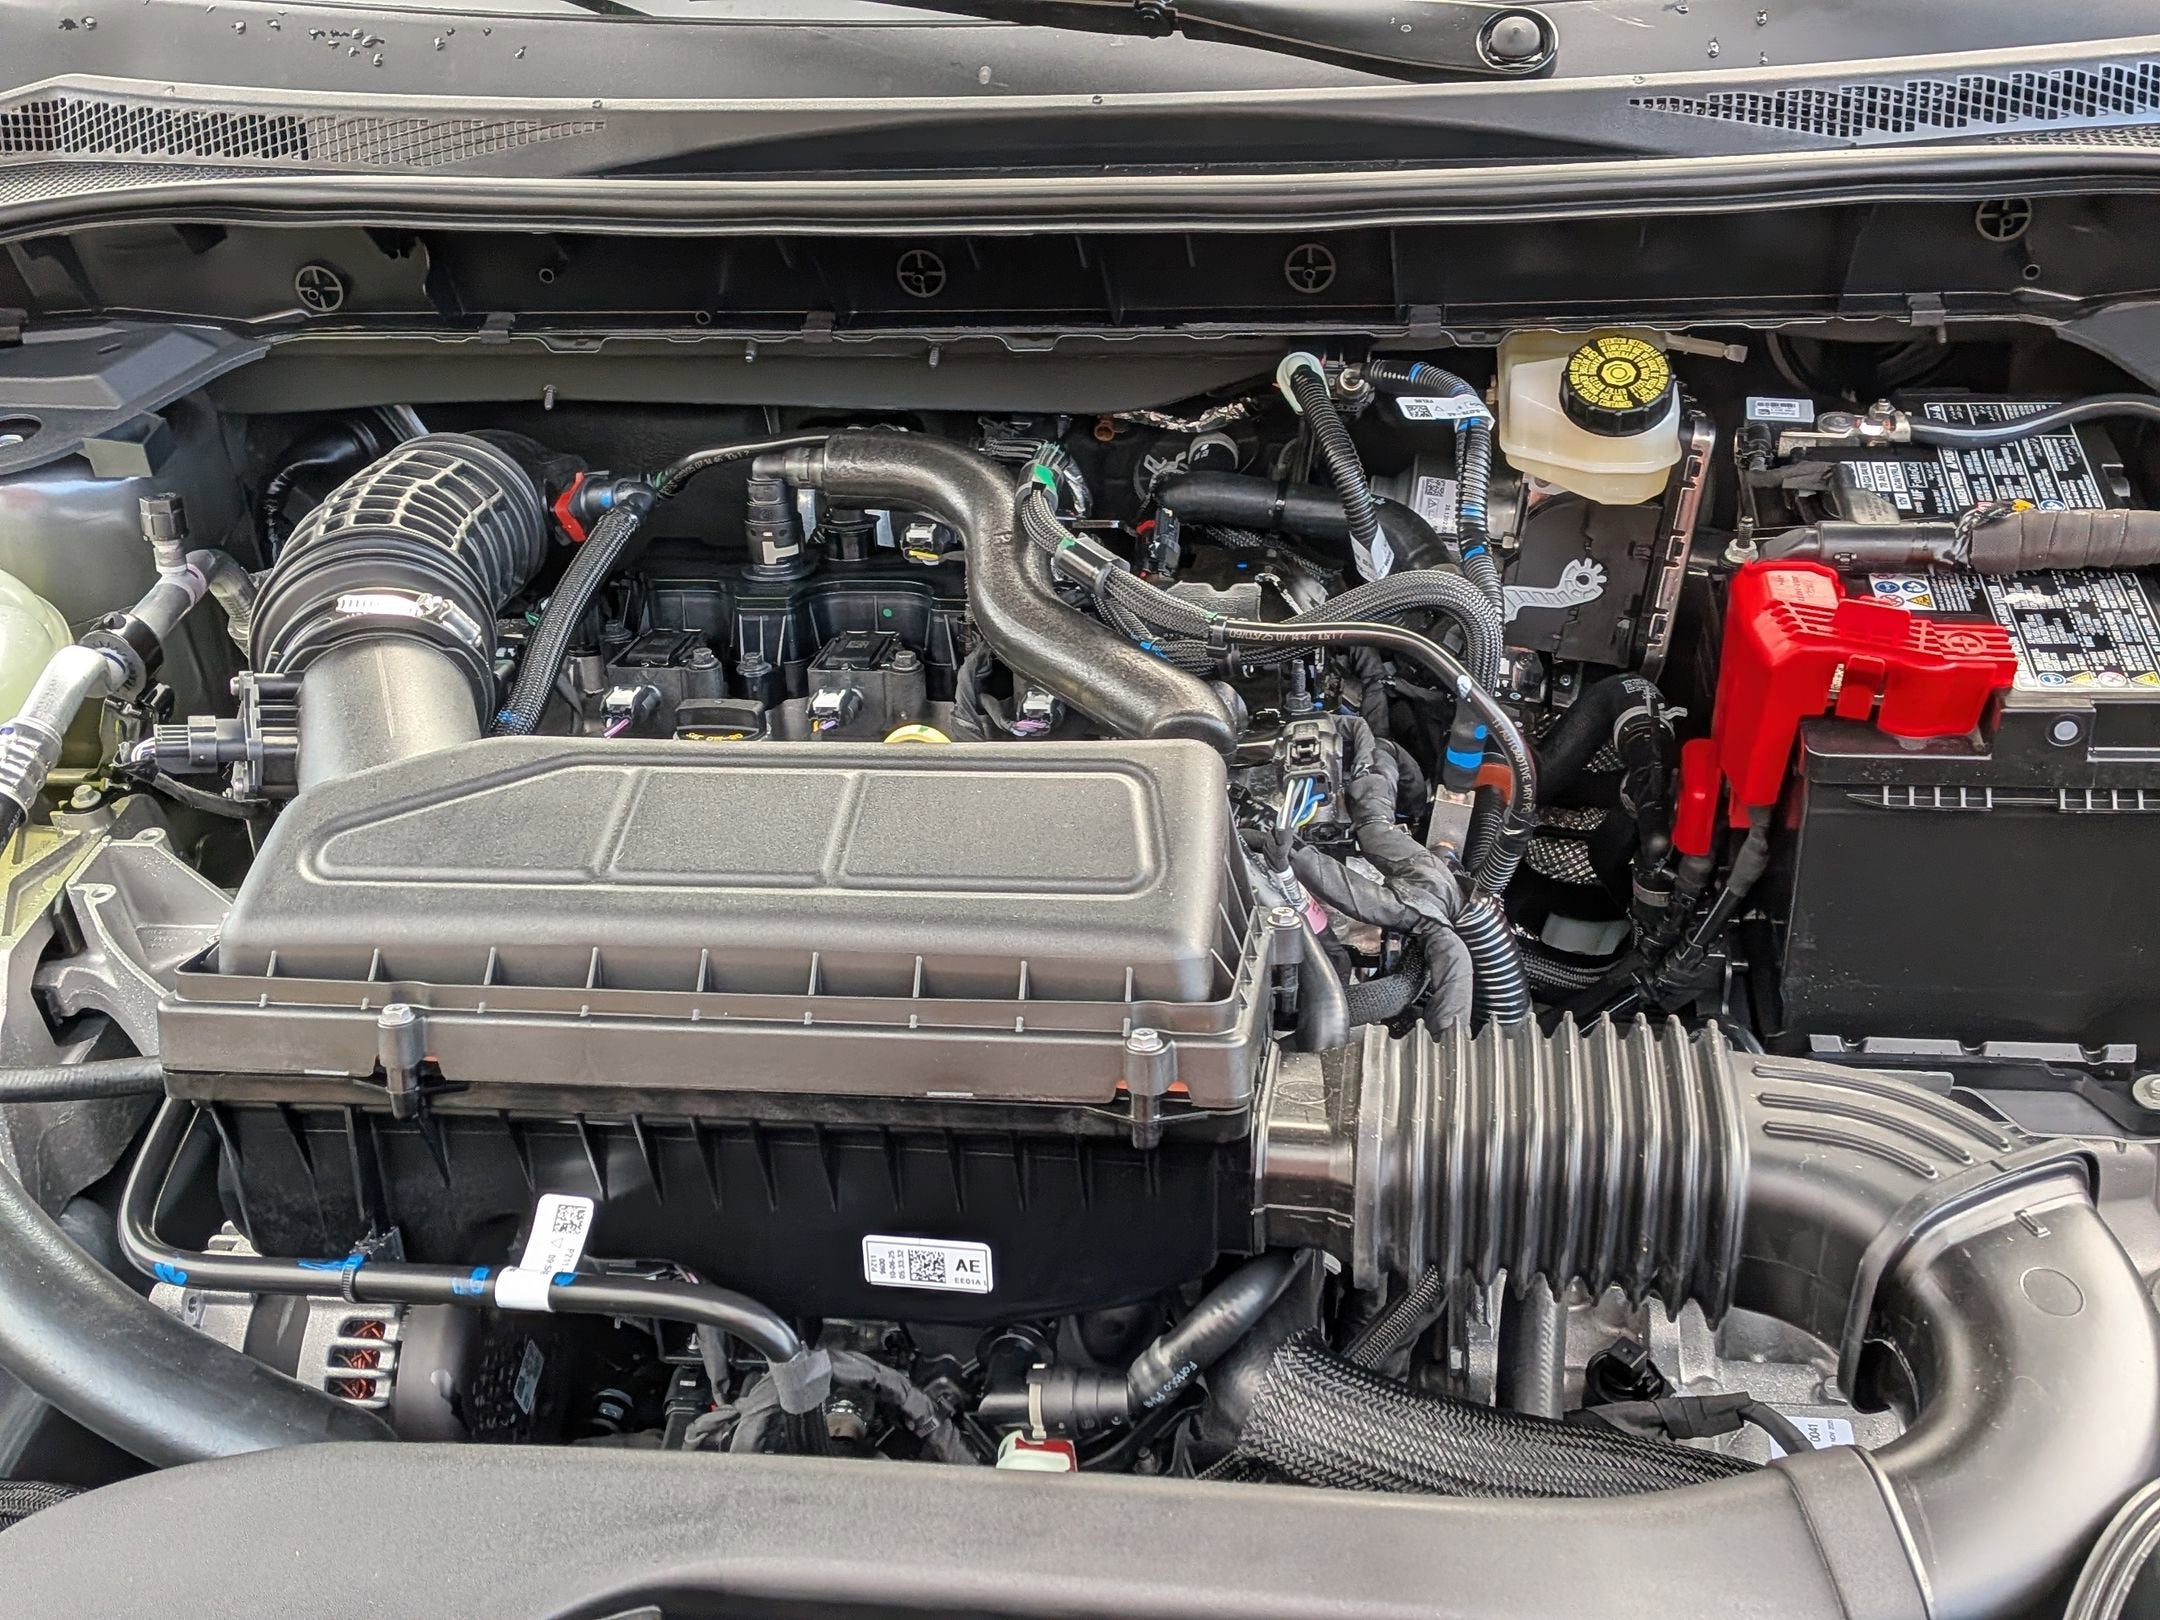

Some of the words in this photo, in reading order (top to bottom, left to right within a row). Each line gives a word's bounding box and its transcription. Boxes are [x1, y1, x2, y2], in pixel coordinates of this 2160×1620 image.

[1499, 729, 1532, 782] AUTOMOTIVE
[955, 1258, 982, 1274] AE
[1807, 1423, 1821, 1443] 0041
